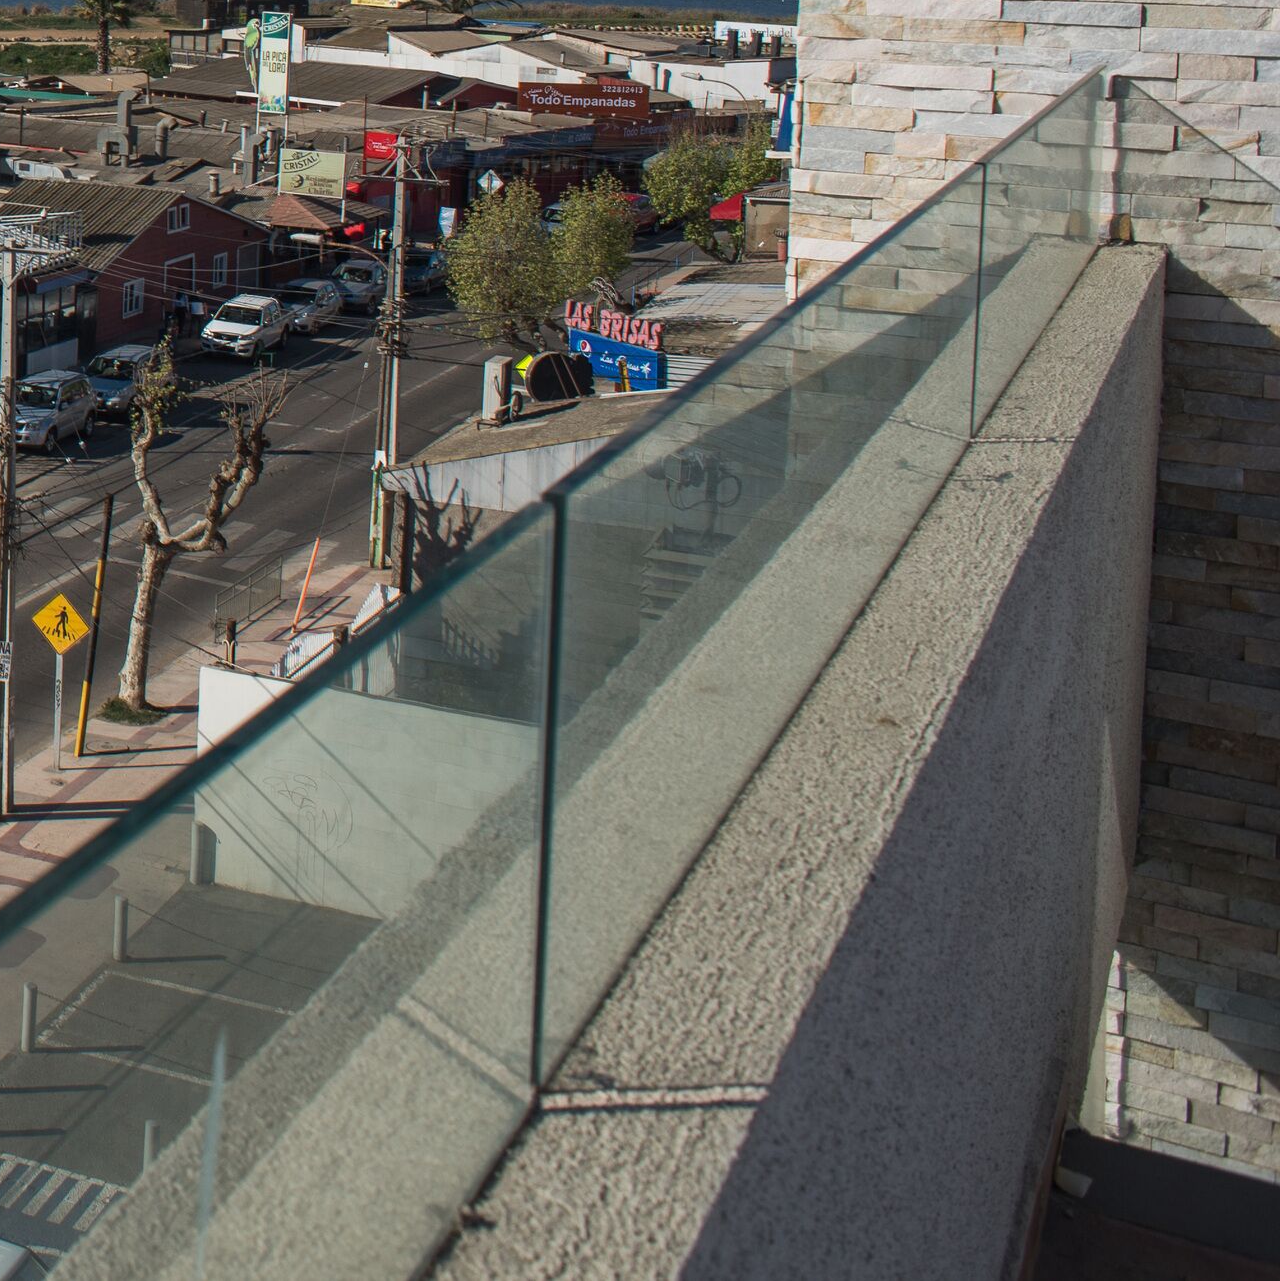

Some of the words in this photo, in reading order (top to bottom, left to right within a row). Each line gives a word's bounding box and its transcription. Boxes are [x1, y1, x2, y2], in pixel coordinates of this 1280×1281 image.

[263, 17, 288, 32] CRISTAL
[777, 27, 793, 38] del
[262, 50, 270, 61] LA
[269, 62, 286, 73] LORO
[602, 85, 644, 94] 322812413
[530, 93, 560, 105] Todo
[562, 95, 637, 108] Empanadas
[623, 127, 638, 138] Todo
[283, 155, 318, 170] CRISTAL
[564, 299, 595, 332] LAS
[600, 309, 664, 351] BRISAS
